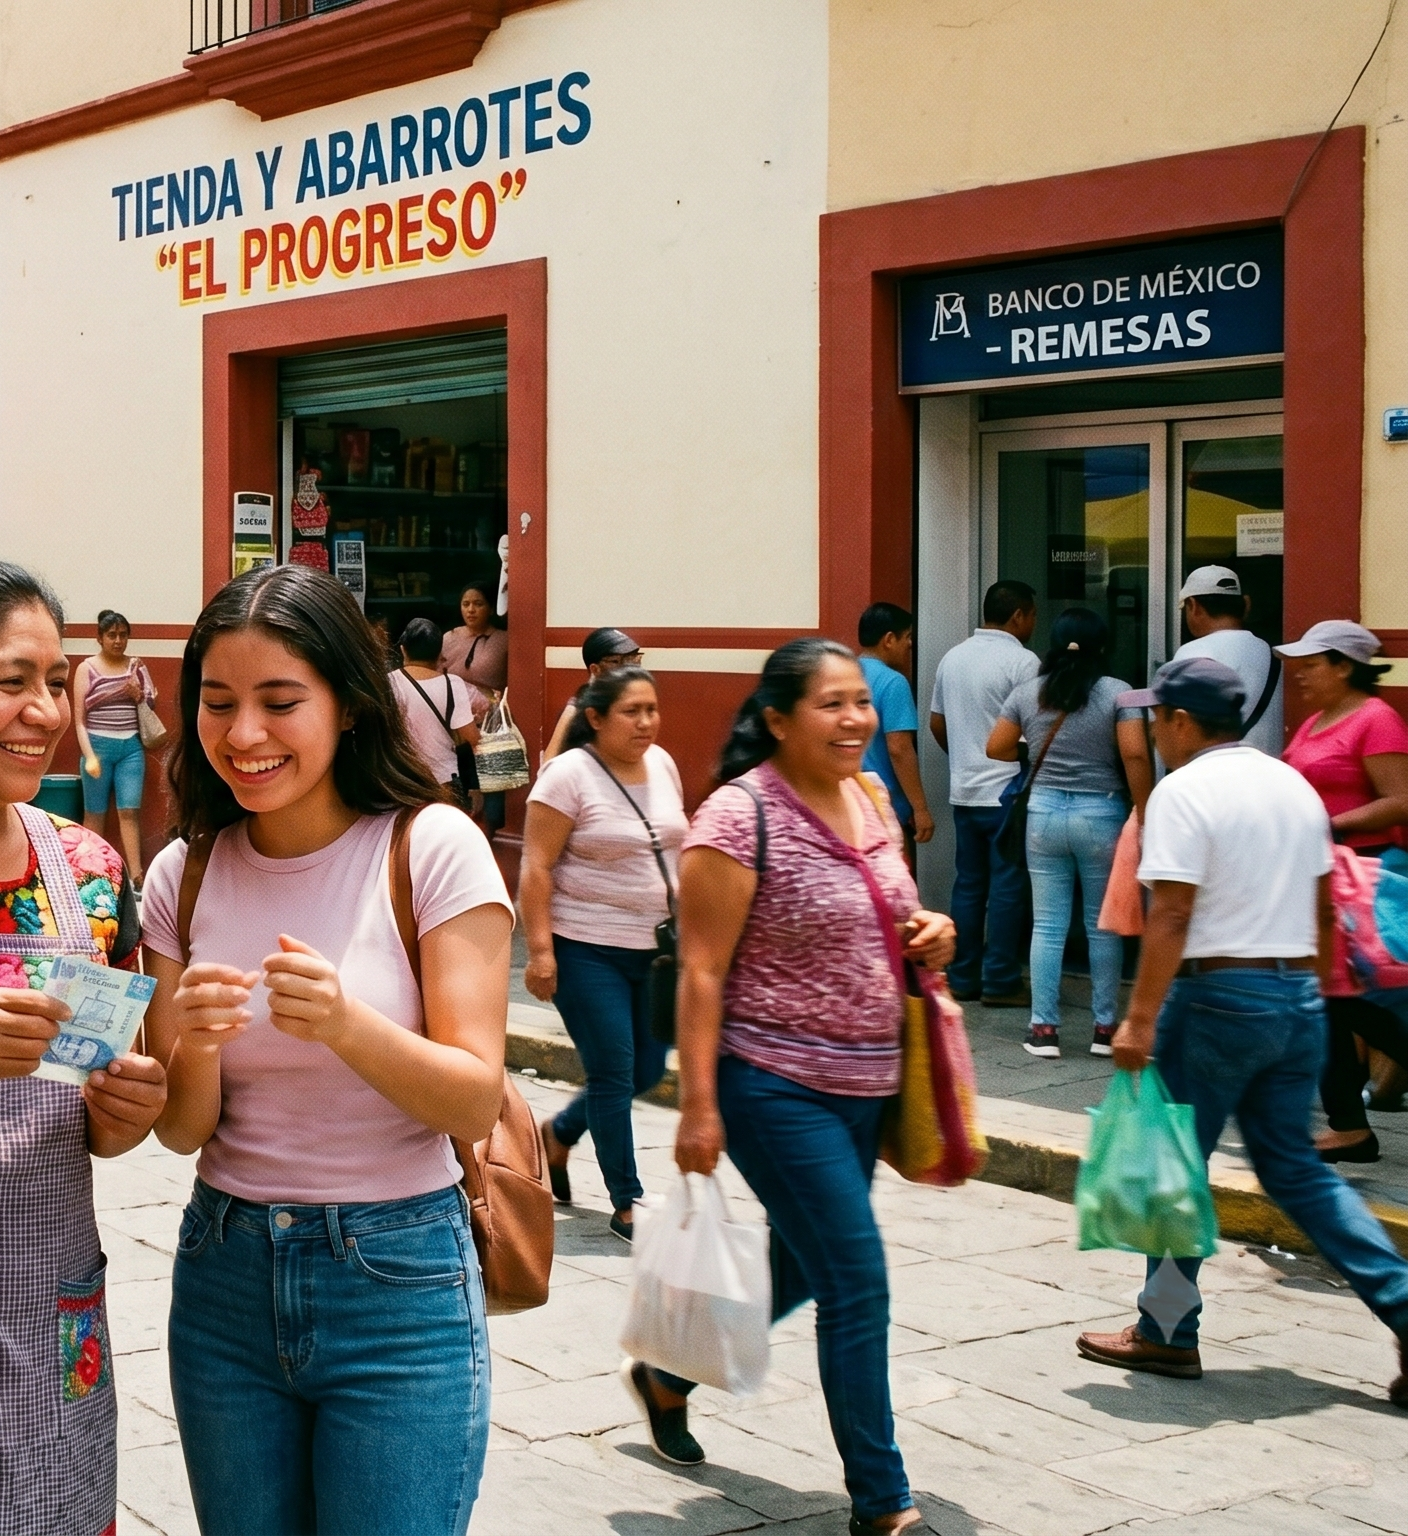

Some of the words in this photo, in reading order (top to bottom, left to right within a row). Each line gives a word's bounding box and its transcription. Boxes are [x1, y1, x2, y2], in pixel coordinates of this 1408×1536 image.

[111, 158, 243, 241] TIENDA
[255, 145, 283, 211] Y
[295, 71, 591, 203] ABARROTES
[987, 282, 1085, 318] BANCO
[1093, 276, 1131, 306] DE
[1139, 261, 1261, 300] MÉXICO
[1010, 308, 1212, 364] REMESAS
